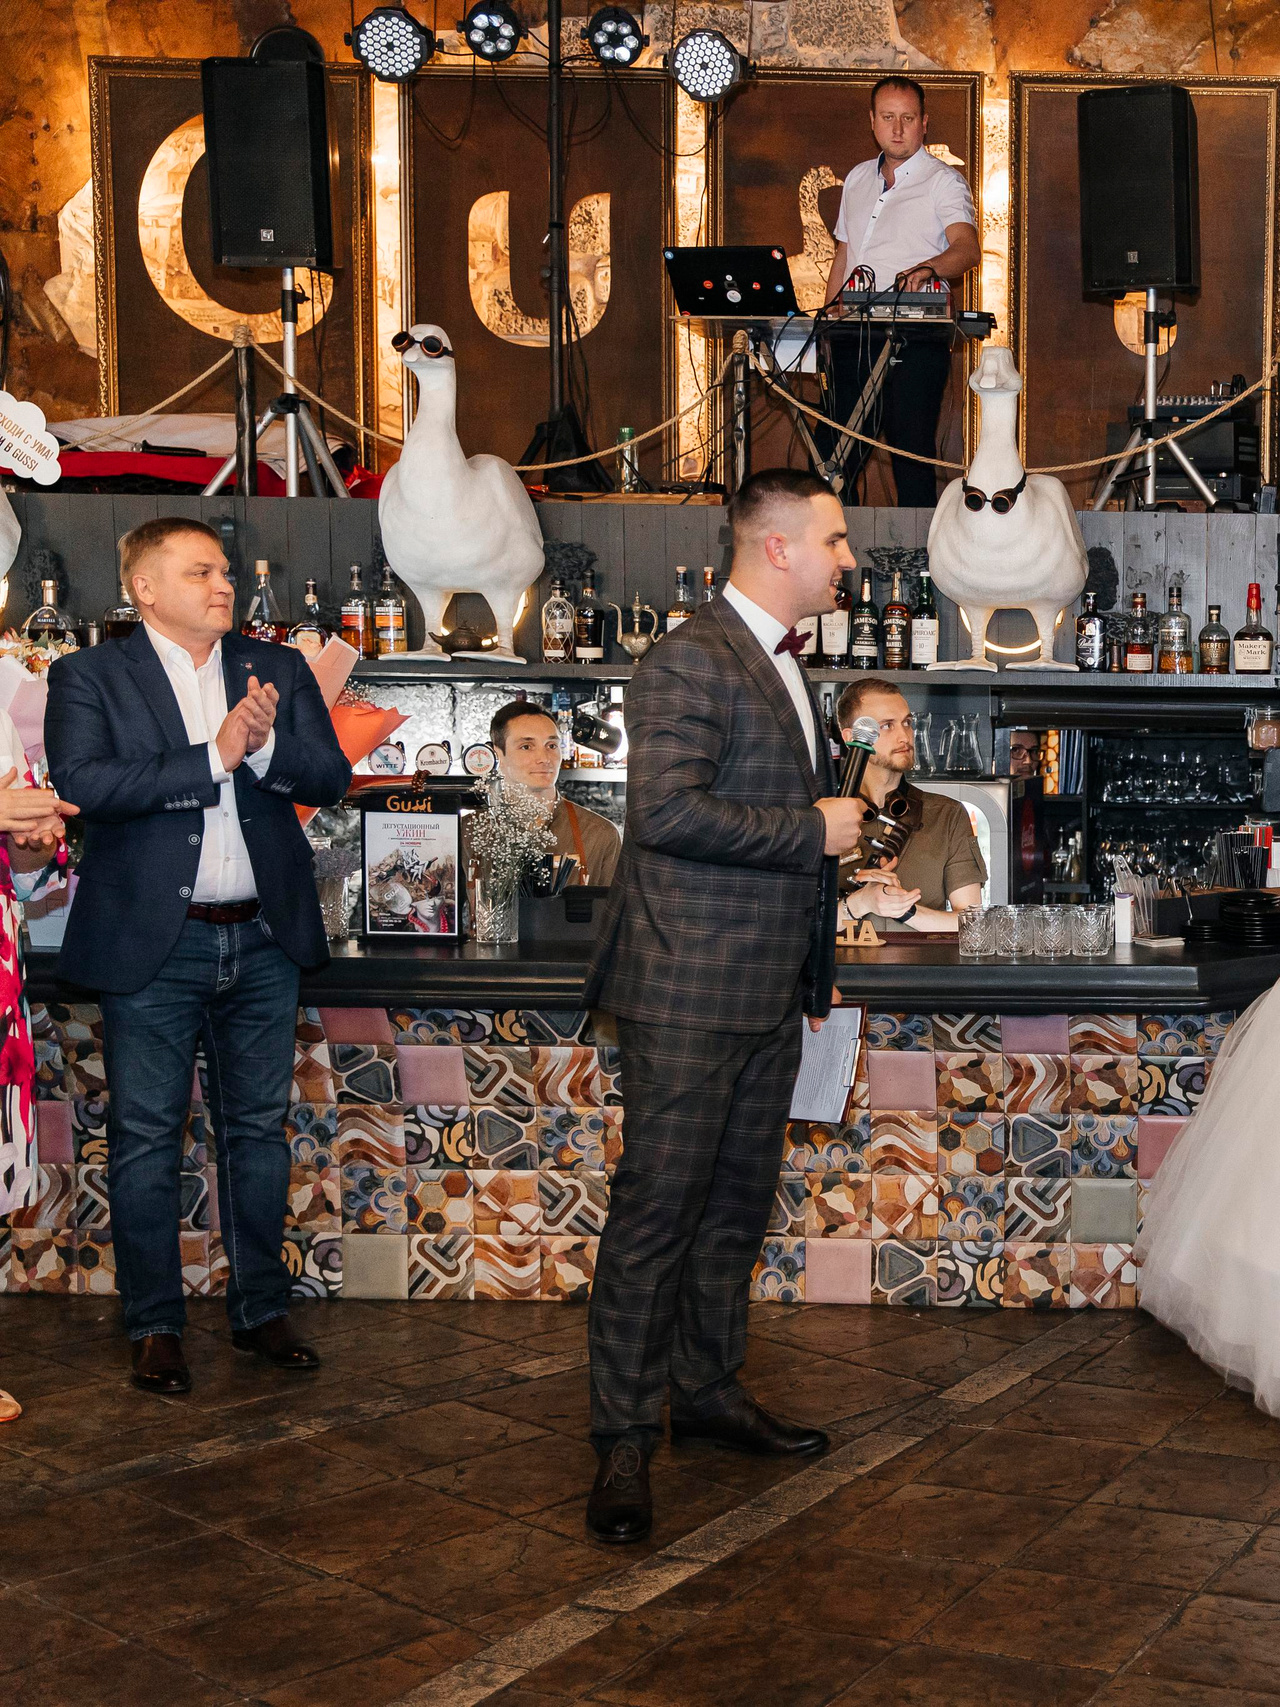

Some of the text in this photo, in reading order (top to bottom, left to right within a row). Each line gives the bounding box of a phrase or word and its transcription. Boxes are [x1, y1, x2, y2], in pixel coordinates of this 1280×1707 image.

[30, 439, 54, 461] УМА!
[12, 448, 39, 471] GUSSI
[854, 617, 878, 625] JAMESON
[396, 829, 426, 837] УЖИН
